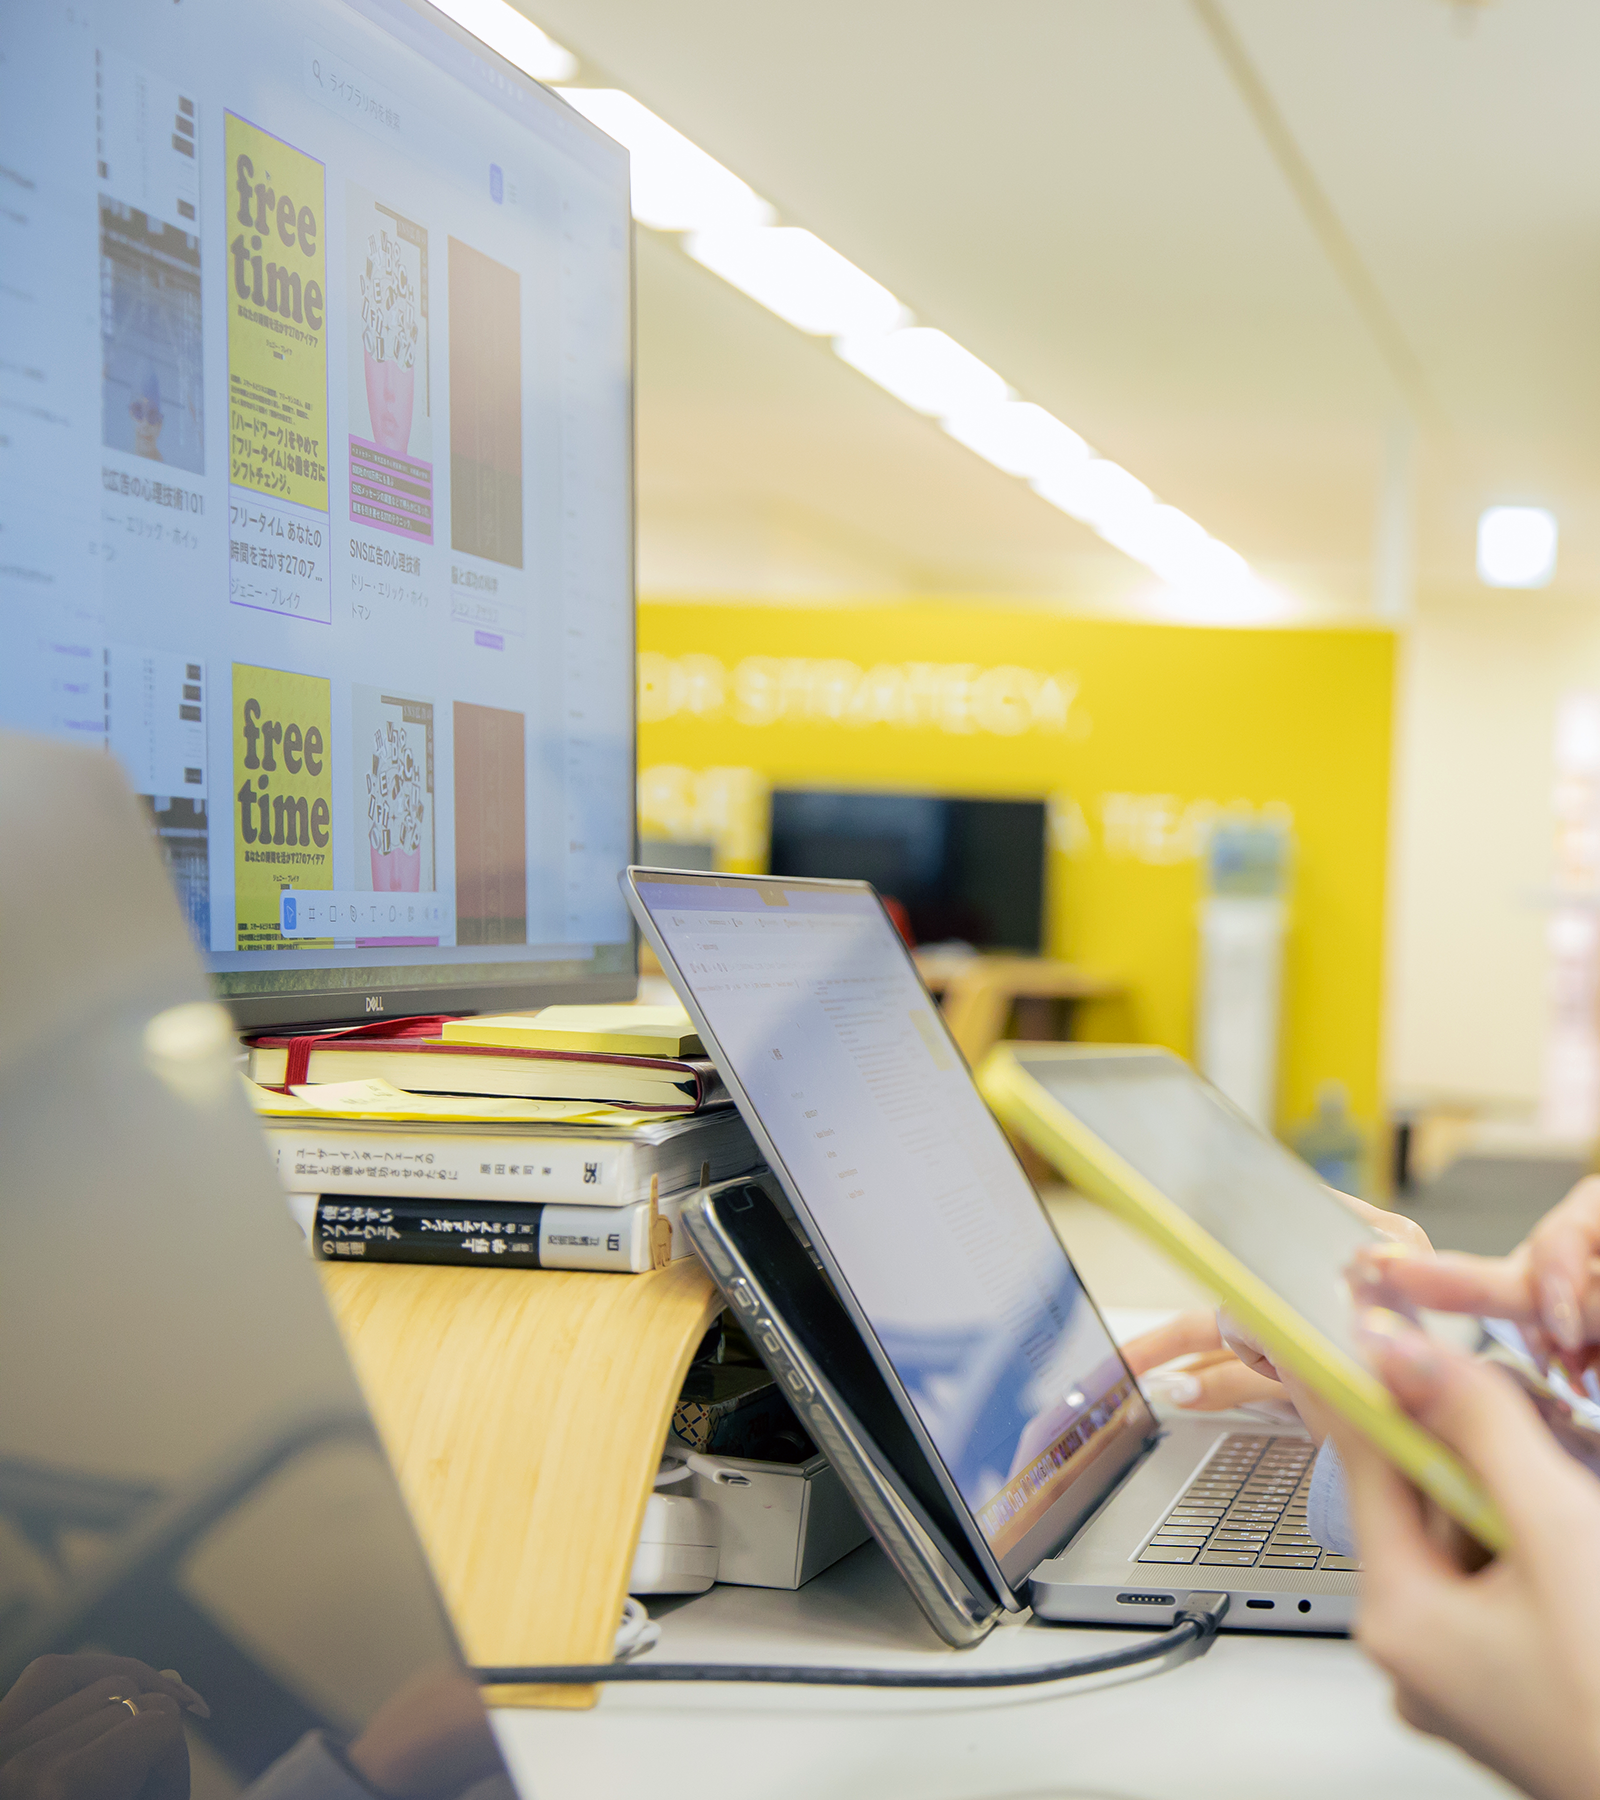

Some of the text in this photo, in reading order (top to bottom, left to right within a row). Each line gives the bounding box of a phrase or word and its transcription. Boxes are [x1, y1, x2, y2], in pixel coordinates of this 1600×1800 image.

[236, 154, 316, 257] free
[230, 233, 323, 331] time
[232, 410, 319, 458] 「ハードワーク」をやめて
[233, 458, 291, 495] シフトチェンジ。
[230, 505, 322, 548] フリータイム あなたの
[350, 538, 421, 576] SNS広告の心理技術
[230, 578, 300, 609] ジェニー・ブレイク
[351, 602, 371, 620] トマン
[243, 698, 323, 777] free
[237, 774, 330, 848] time
[365, 996, 384, 1012] DELL
[296, 1148, 435, 1164] ユーザーインターフェースの
[480, 1163, 534, 1176] 原田秀司
[294, 1163, 459, 1181] 設計と改善を成功させるために
[583, 1162, 598, 1185] SE
[322, 1205, 394, 1223] 使いやすい
[322, 1224, 402, 1241] ソフトウェア
[322, 1240, 367, 1256] の原理
